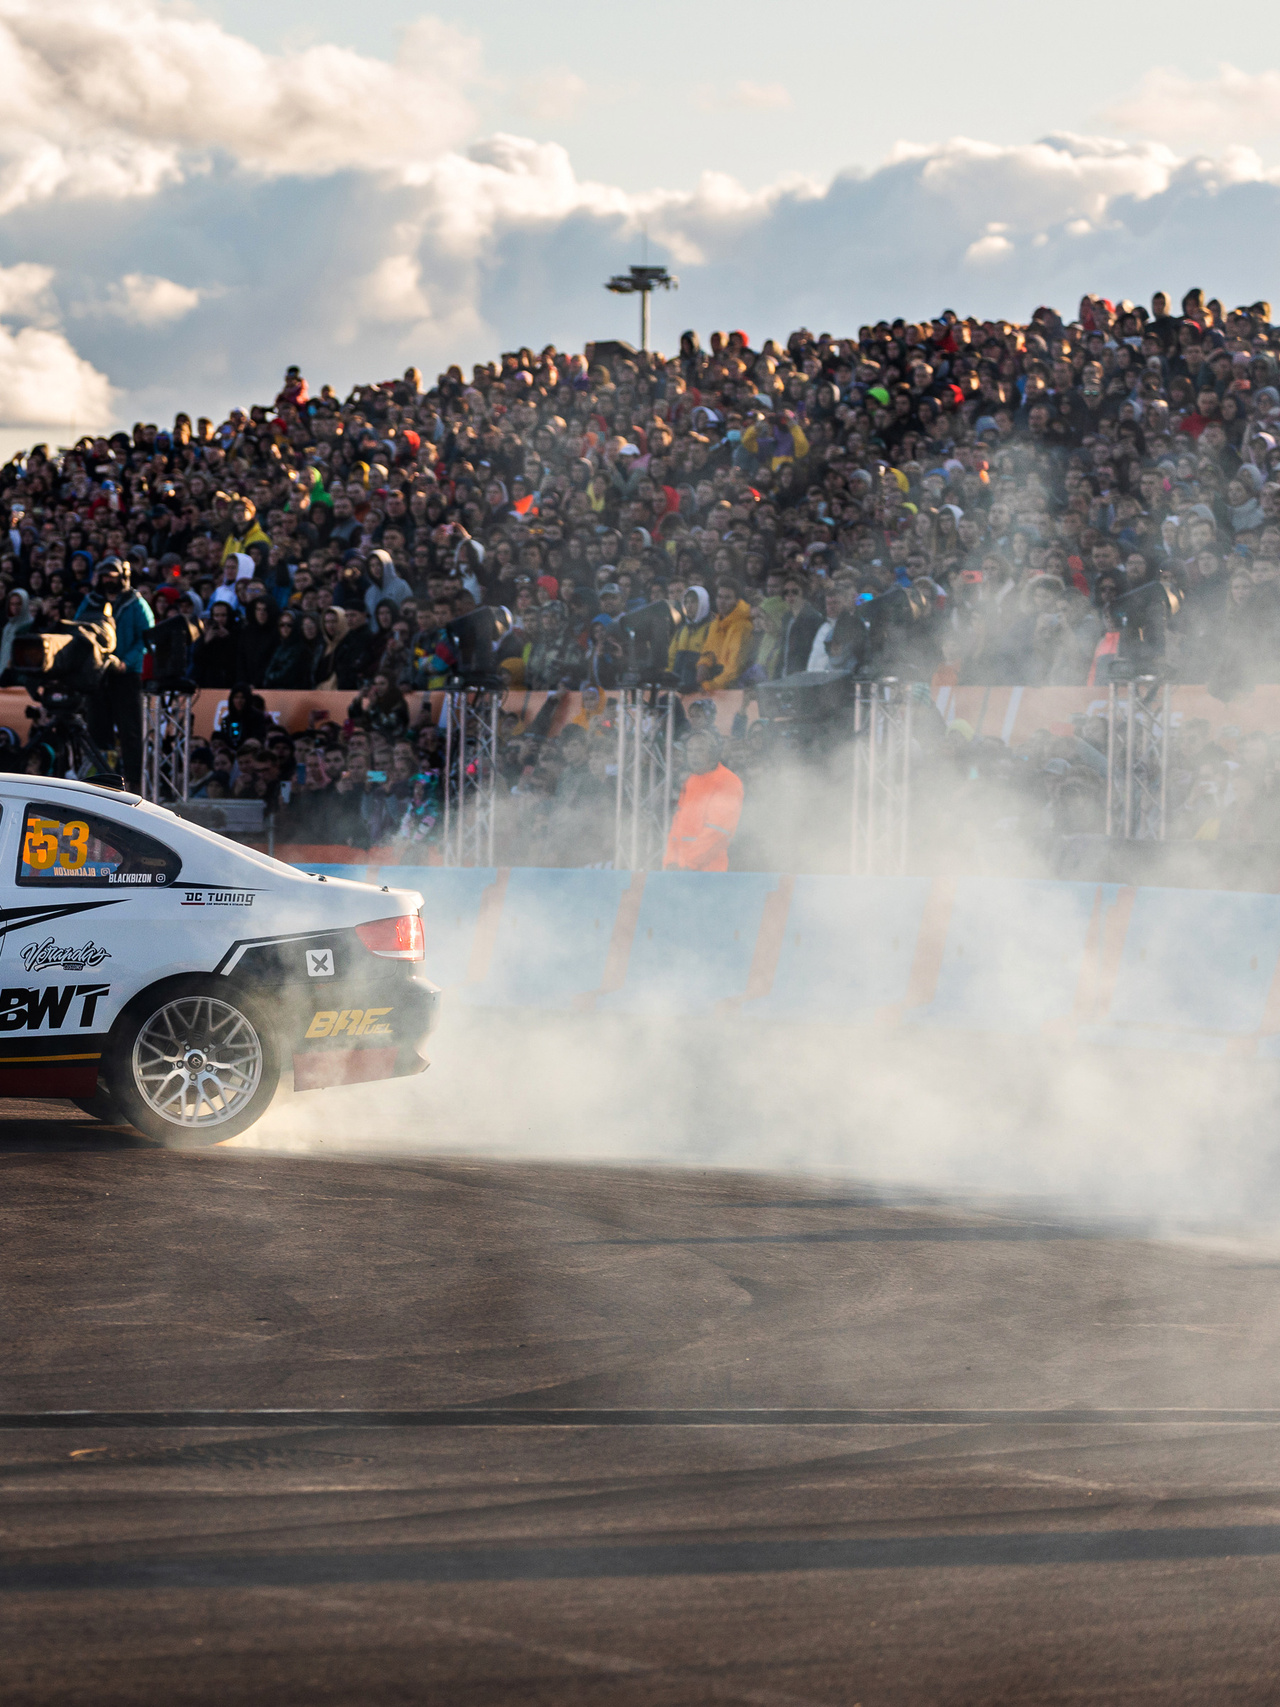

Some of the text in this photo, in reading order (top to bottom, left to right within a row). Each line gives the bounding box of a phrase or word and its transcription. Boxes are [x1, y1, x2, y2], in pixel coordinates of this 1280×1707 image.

[29, 820, 90, 870] 53
[108, 873, 152, 883] BLACKBIZON
[185, 892, 203, 902] DC
